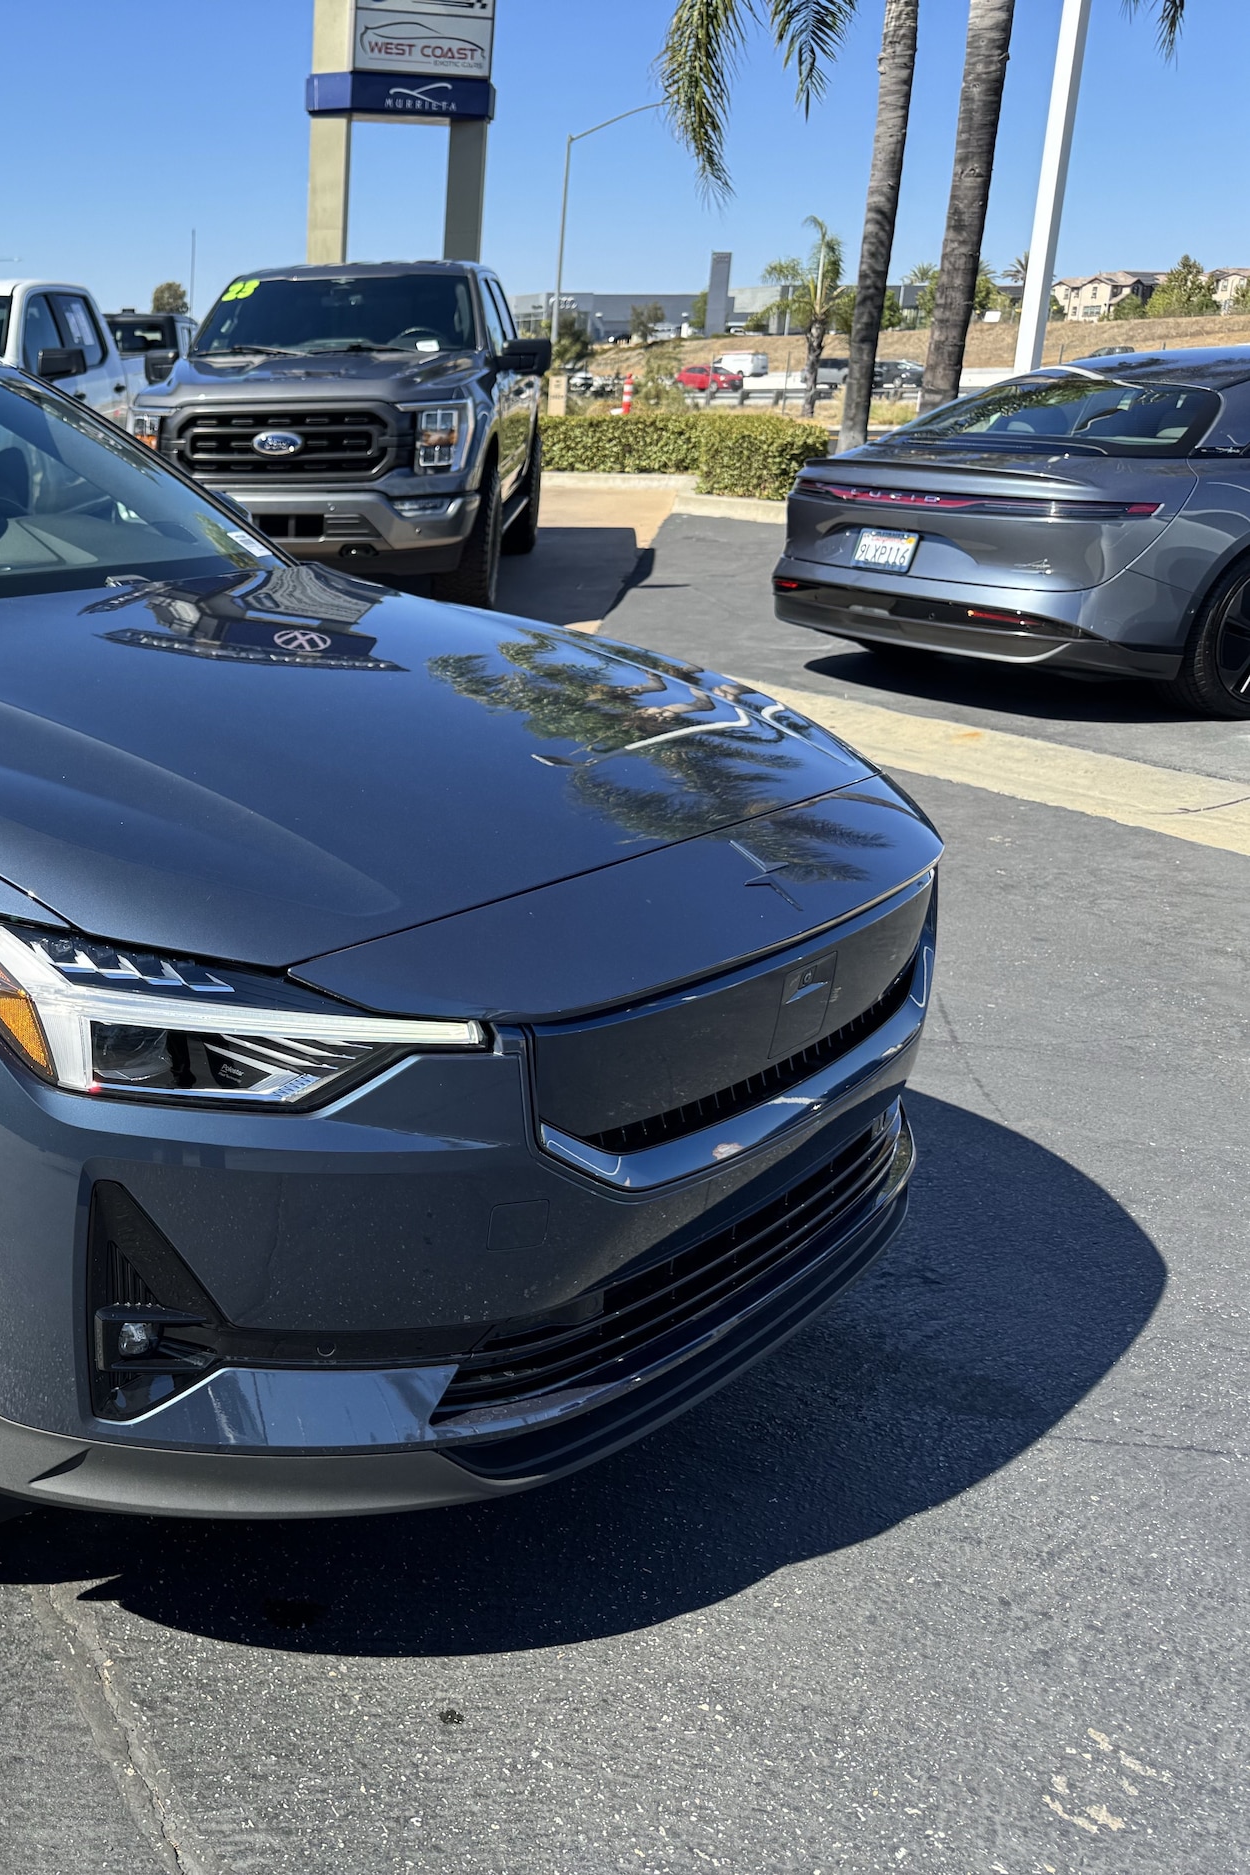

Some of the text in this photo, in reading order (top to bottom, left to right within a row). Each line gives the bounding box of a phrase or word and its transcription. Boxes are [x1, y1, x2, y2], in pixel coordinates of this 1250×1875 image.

[368, 41, 478, 61] WEST COAST
[384, 98, 457, 112] MURRIETA
[857, 544, 909, 565] 9LXP116
